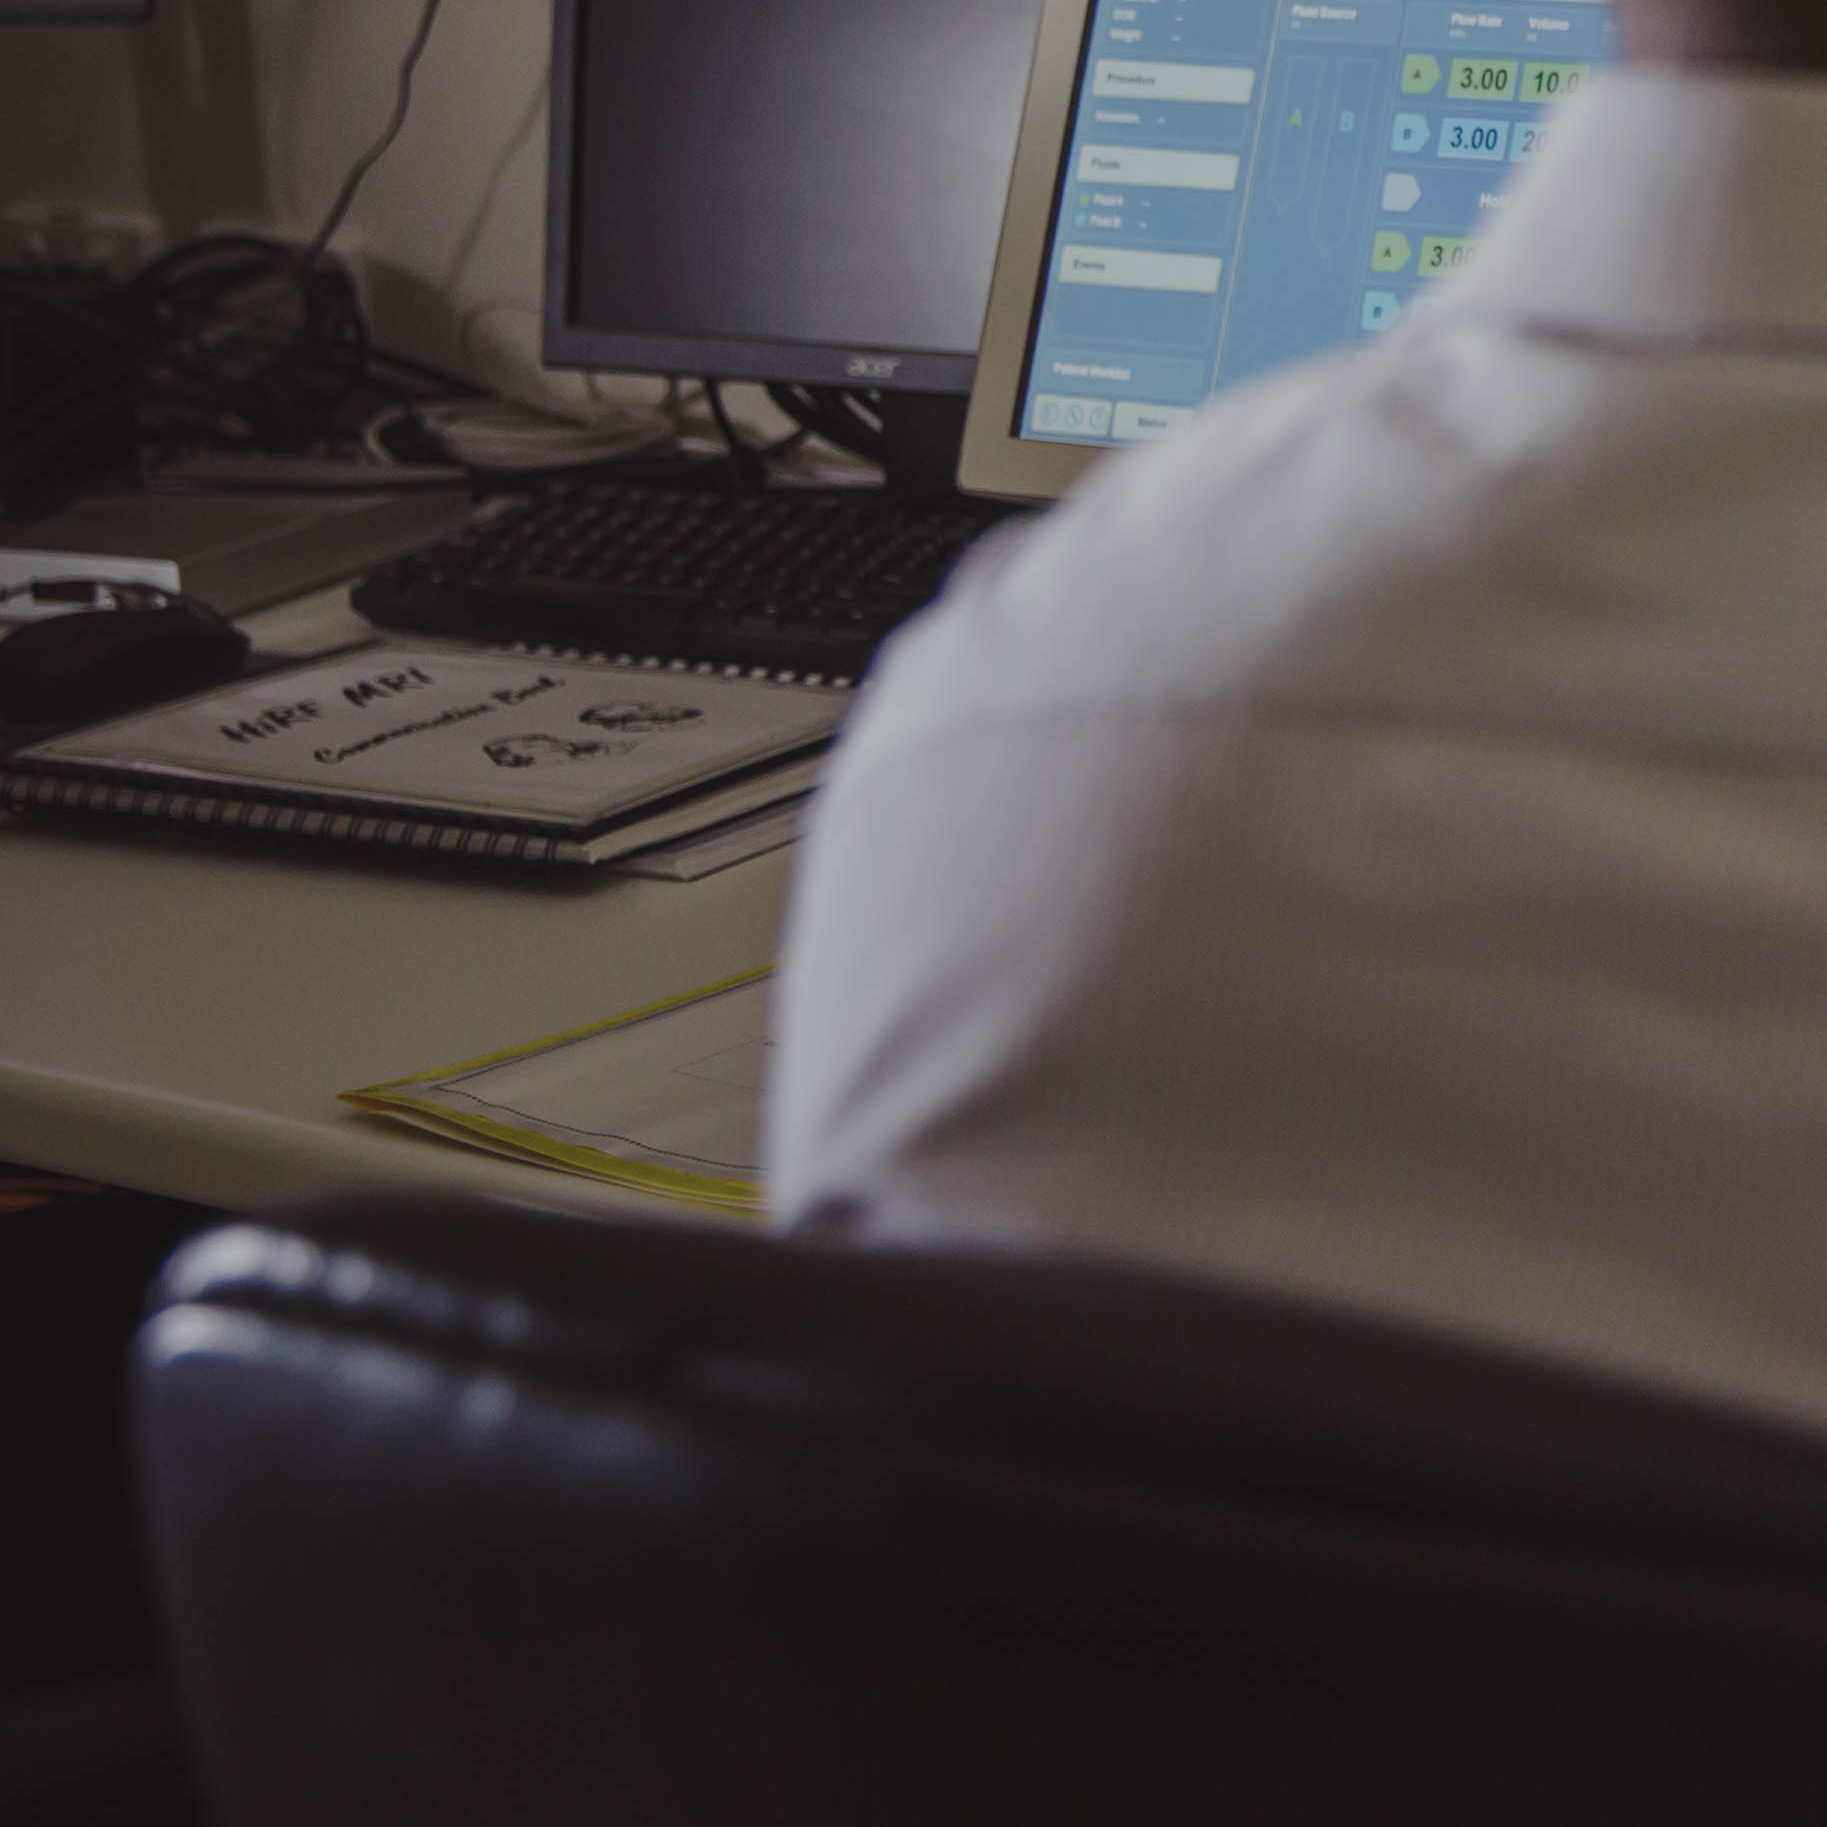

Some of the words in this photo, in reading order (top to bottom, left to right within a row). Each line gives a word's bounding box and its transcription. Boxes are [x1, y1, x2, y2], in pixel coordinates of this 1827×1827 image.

[1460, 66, 1508, 92] 3.00
[1449, 126, 1499, 151] 3.00
[341, 665, 435, 708] MRI
